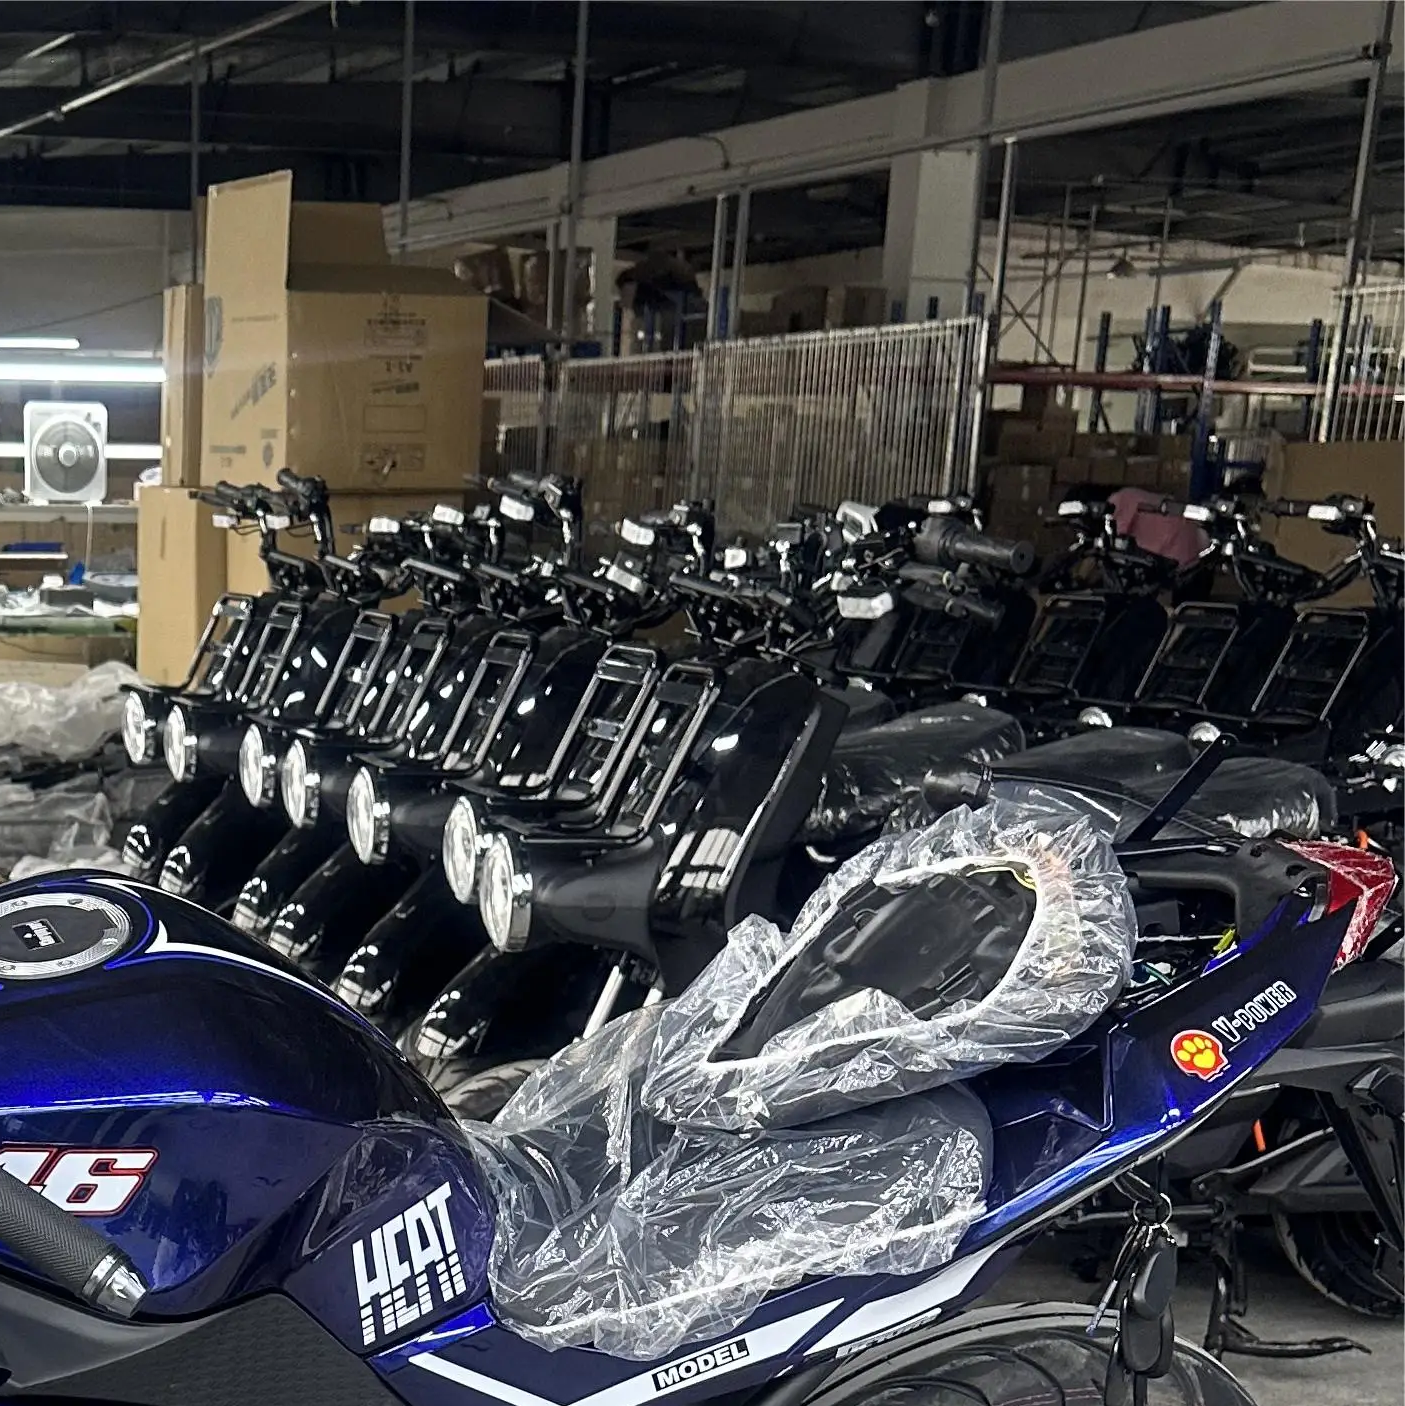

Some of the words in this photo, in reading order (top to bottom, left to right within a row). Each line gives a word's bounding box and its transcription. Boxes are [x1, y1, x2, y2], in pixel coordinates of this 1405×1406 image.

[1211, 980, 1298, 1043] V-POWER
[352, 1181, 457, 1310] HEAT
[657, 1341, 749, 1390] MODEL
